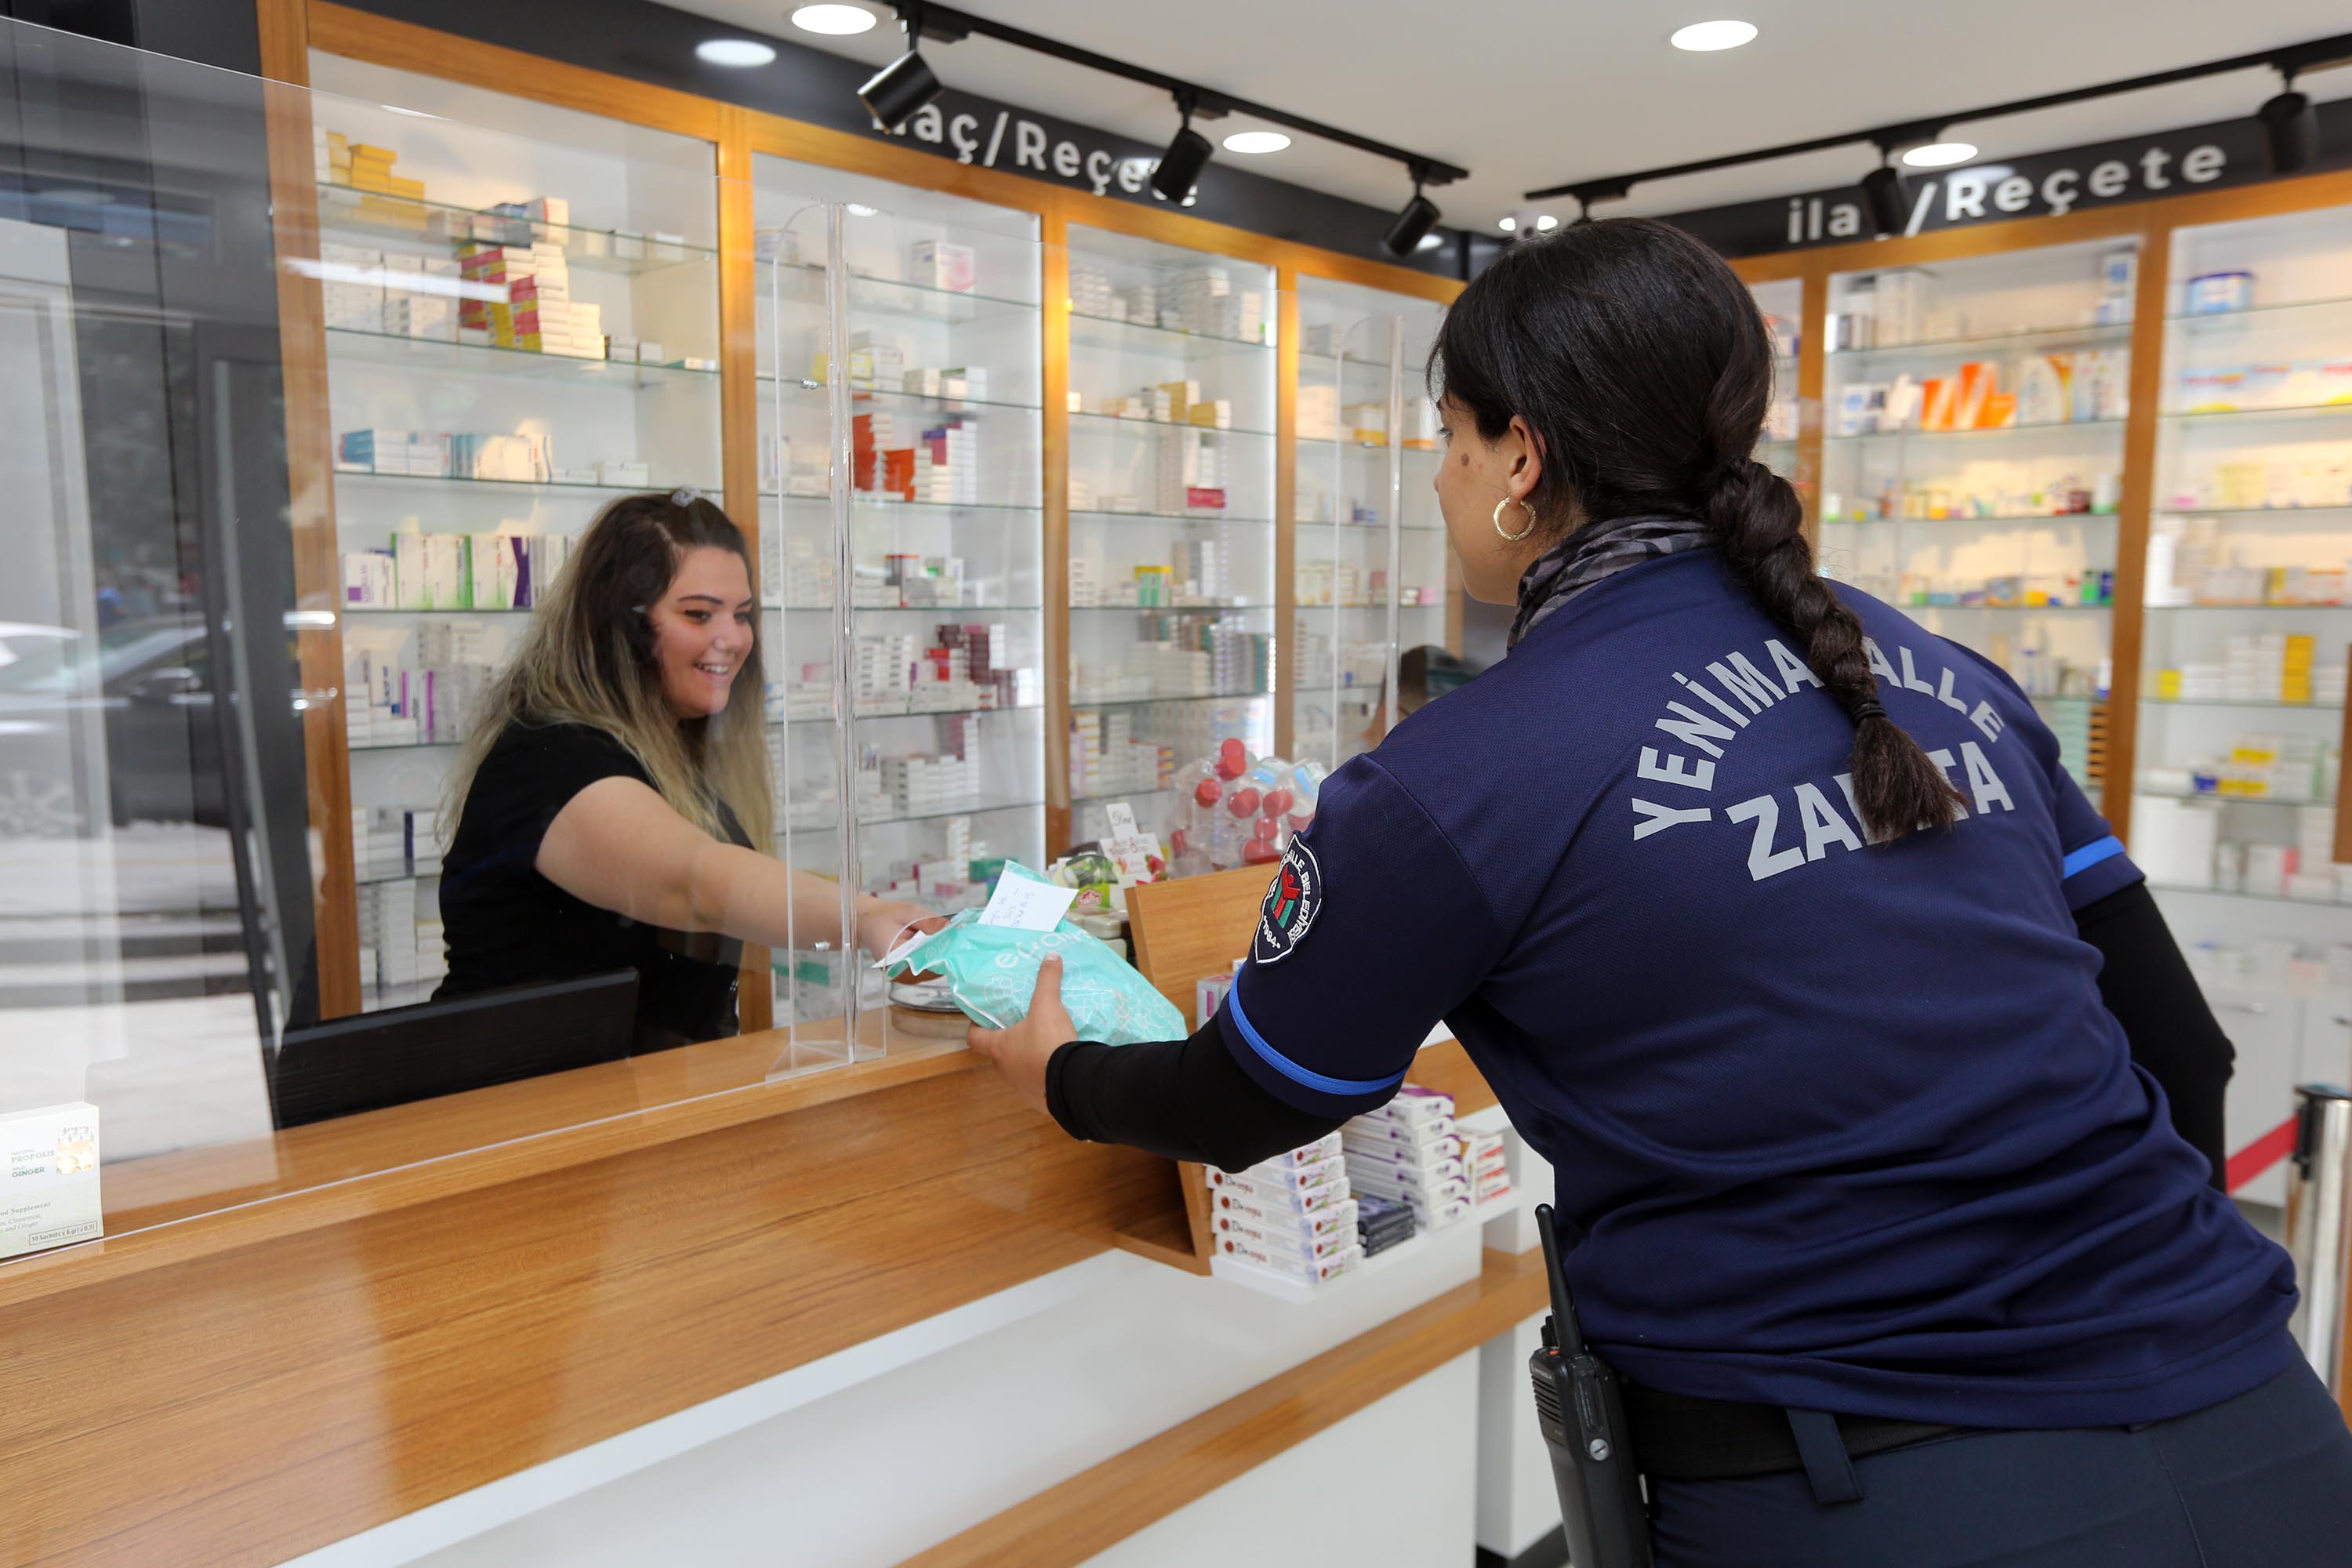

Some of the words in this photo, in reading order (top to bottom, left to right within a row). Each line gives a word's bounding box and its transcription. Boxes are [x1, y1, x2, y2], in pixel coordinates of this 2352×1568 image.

[872, 103, 1199, 208] aç/Reçe
[1787, 143, 2227, 242] ila/Reçete
[1632, 636, 2005, 841] YENİMAALLE
[12, 1150, 55, 1163] PROPOLIS
[12, 1167, 45, 1178] GINGER
[10, 1201, 51, 1214] Supplement
[39, 1232, 60, 1241] Sachets
